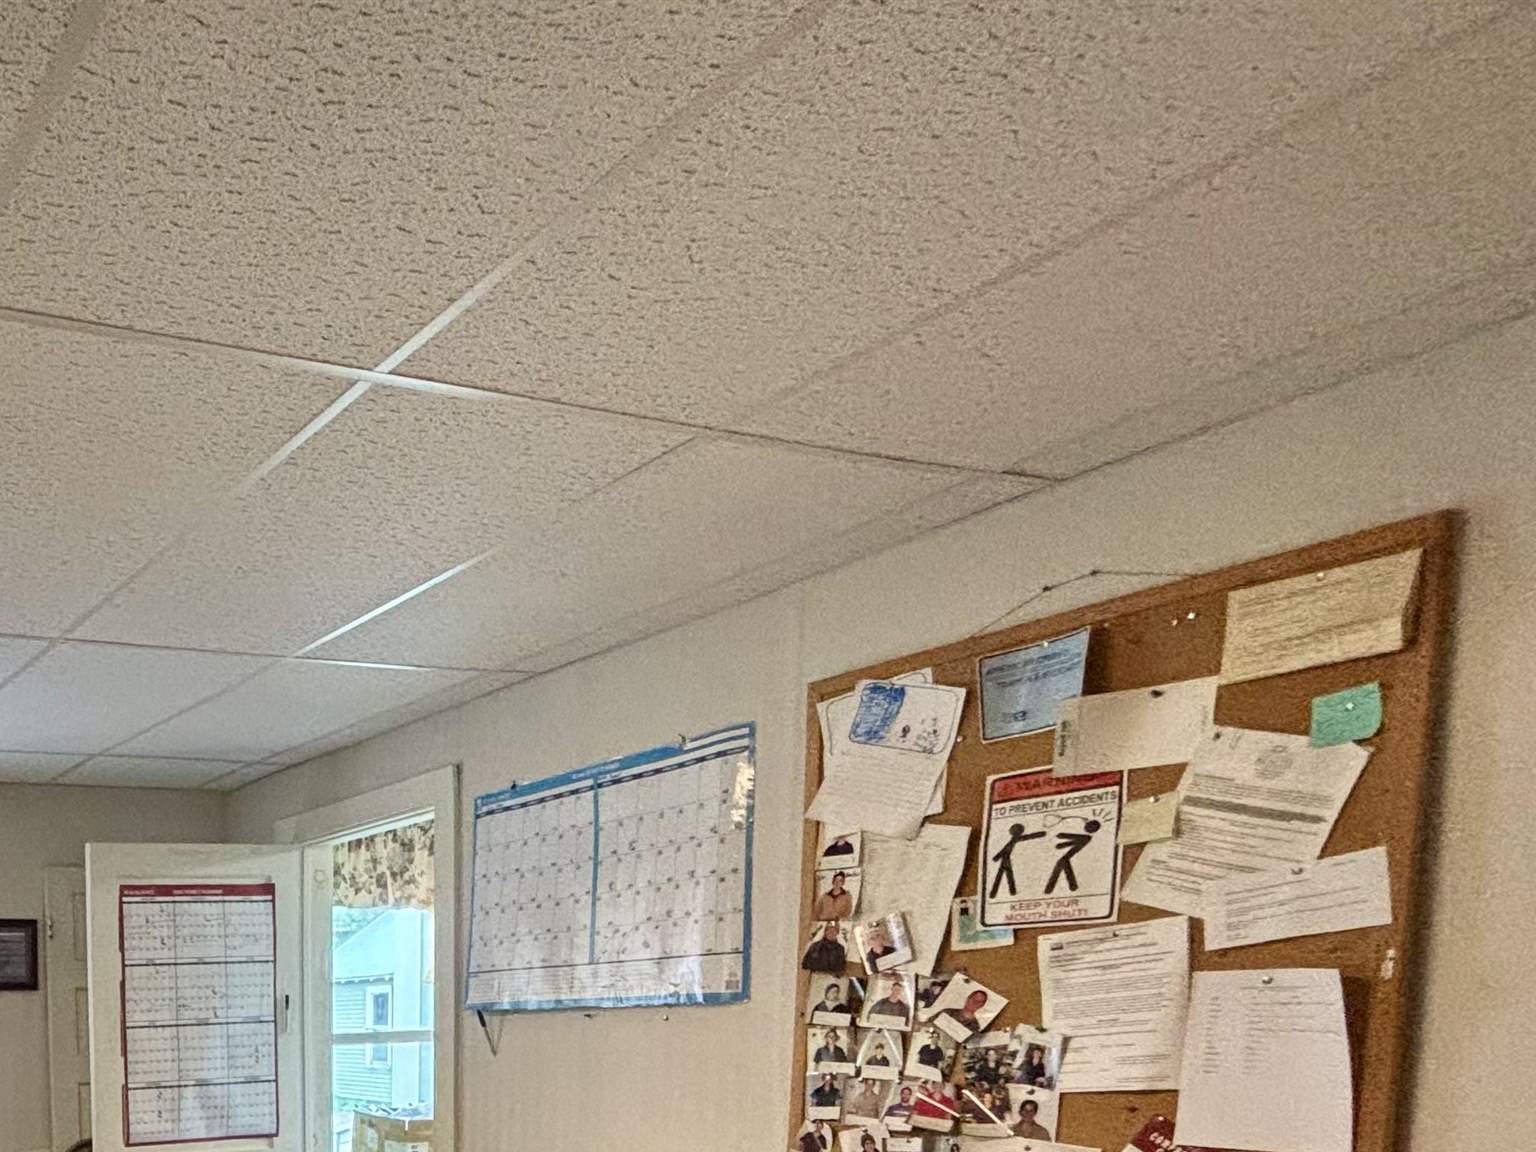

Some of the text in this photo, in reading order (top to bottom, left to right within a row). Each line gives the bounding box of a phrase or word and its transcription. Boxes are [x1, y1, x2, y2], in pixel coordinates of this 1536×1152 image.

[994, 790, 1118, 816] TO PREVENT ACCIDENTS
[1010, 899, 1080, 912] KEEP YOUR
